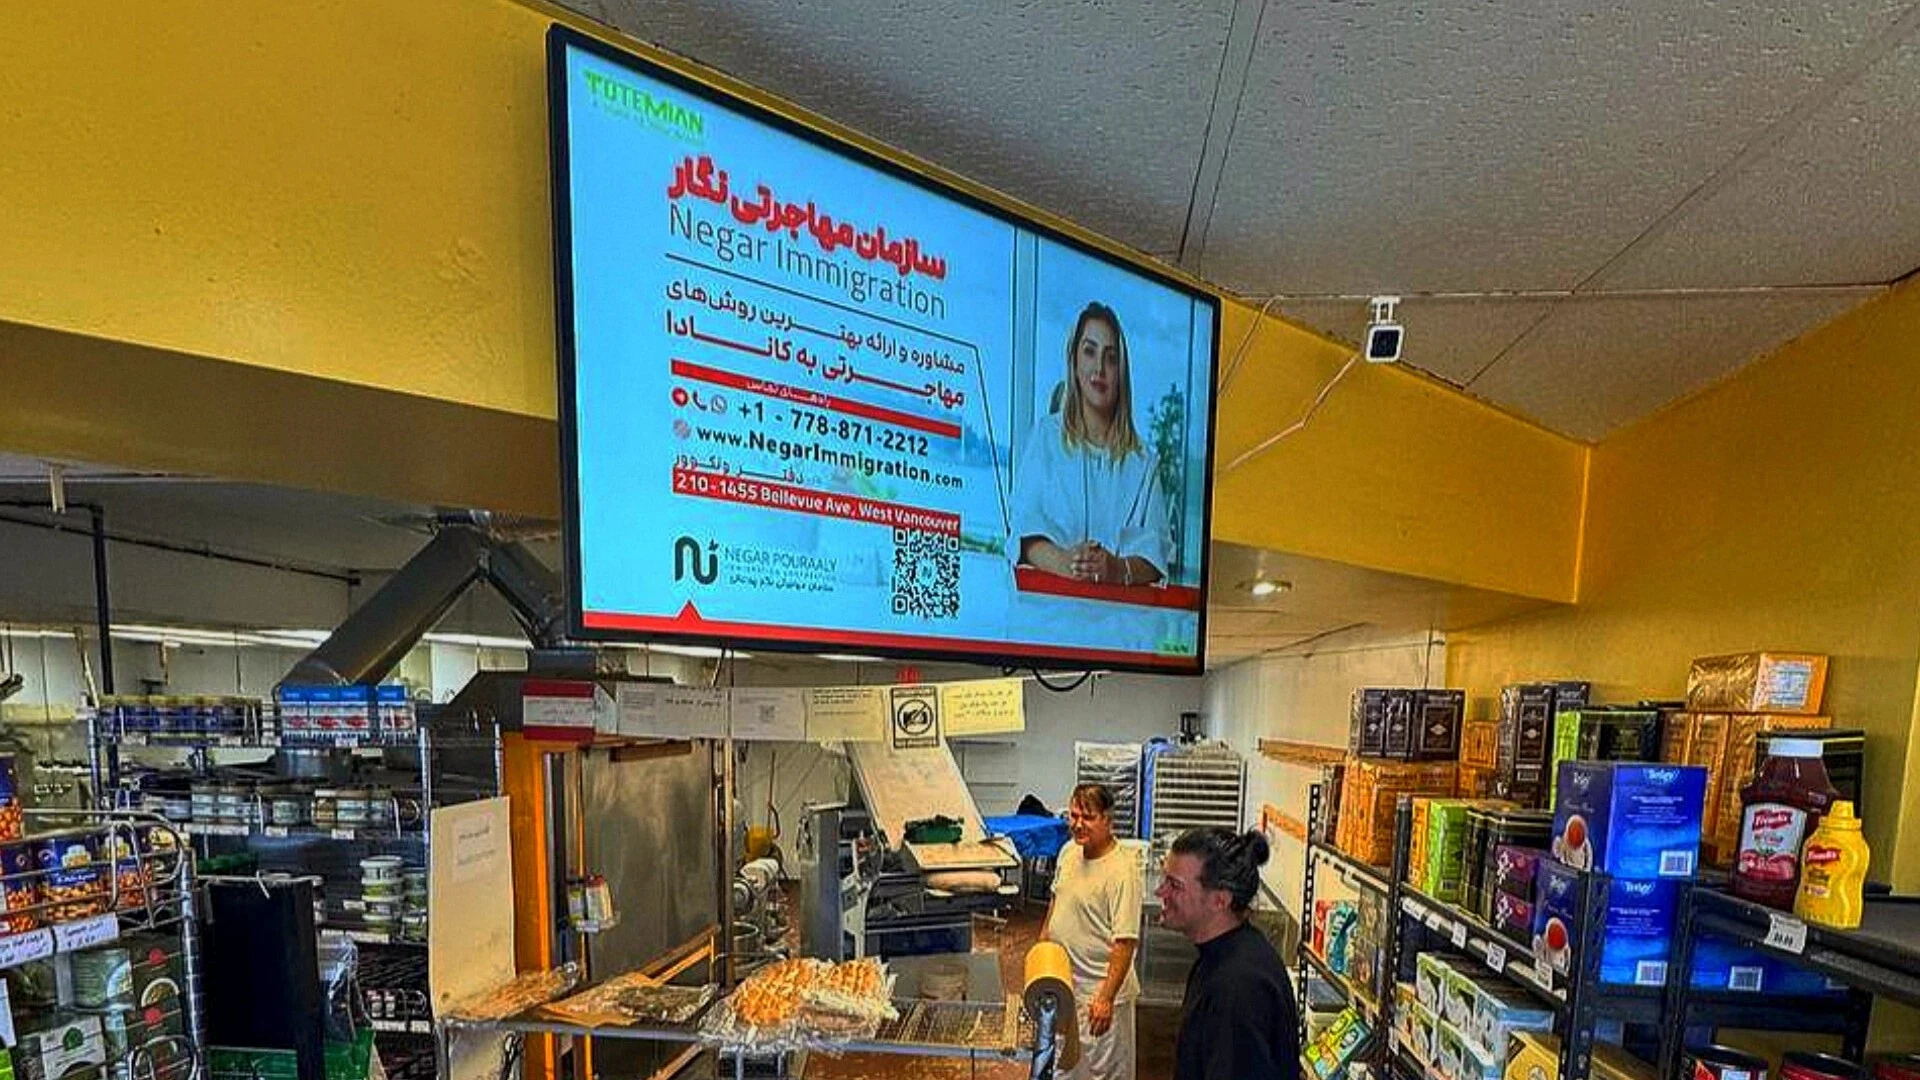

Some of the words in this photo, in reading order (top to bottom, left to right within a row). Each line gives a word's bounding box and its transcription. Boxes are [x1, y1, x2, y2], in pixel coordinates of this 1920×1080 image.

[668, 155, 728, 203] نگار
[731, 185, 854, 250] مهاجرتی
[670, 203, 768, 262] Negar
[777, 239, 946, 320] Immigration
[856, 226, 946, 279] سازمان
[796, 351, 818, 374] به
[900, 346, 909, 362] و
[911, 348, 965, 375] مشاوره
[739, 401, 764, 423] +1
[791, 409, 928, 456] 778-871-2212
[697, 427, 964, 489] www.NegarImmigration.com
[760, 486, 823, 511] Bellevue
[858, 502, 894, 522] West
[895, 508, 959, 532] Vancouver
[725, 547, 770, 566] NEGAR
[773, 552, 837, 573] POURAALY
